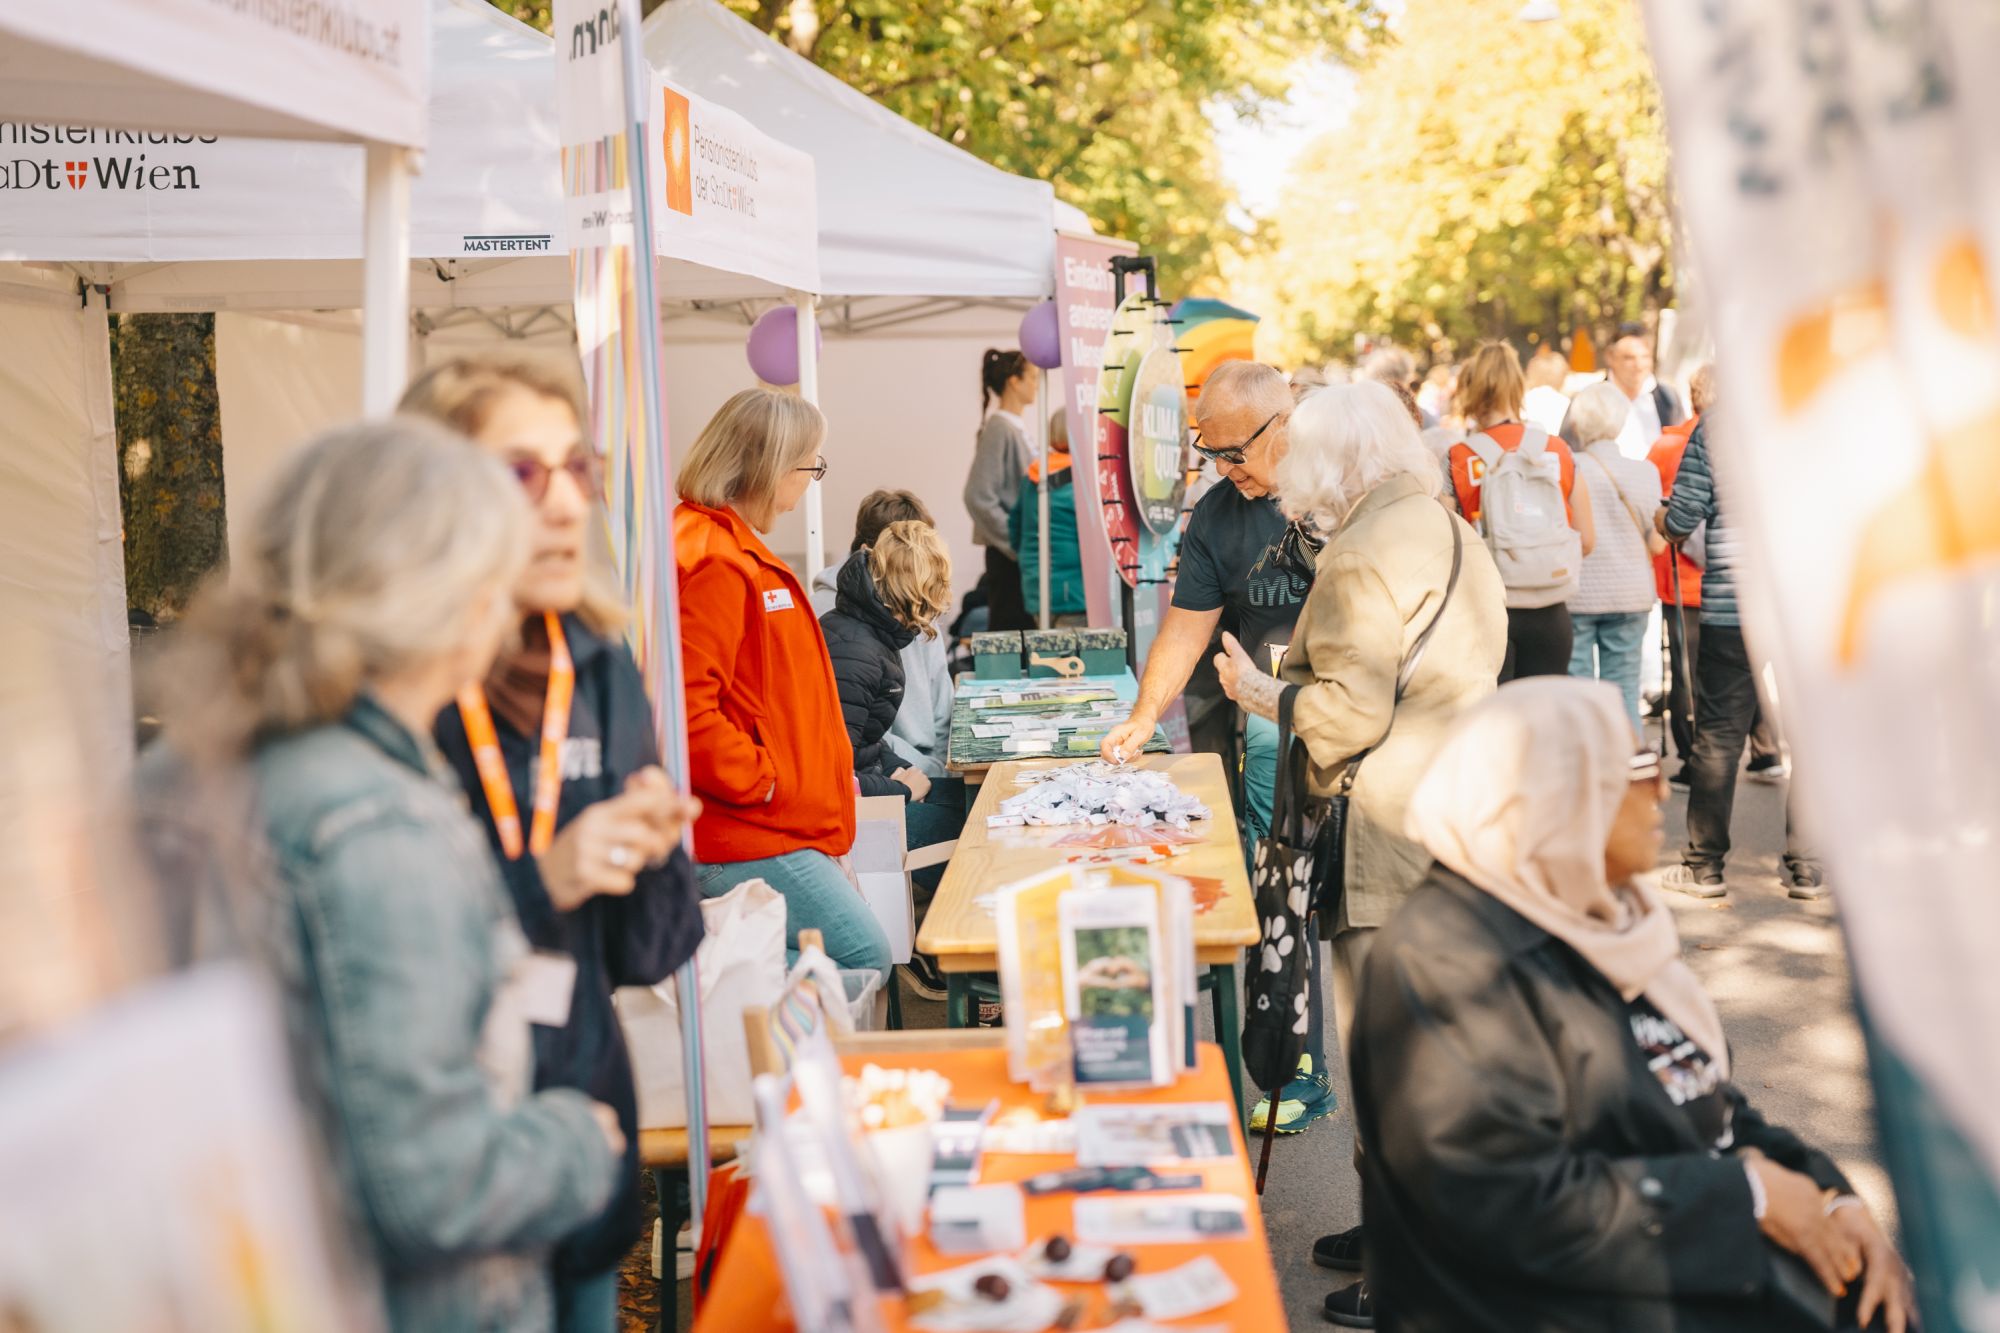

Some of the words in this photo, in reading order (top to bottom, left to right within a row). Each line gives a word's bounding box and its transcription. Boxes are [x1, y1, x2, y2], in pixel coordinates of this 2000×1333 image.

[93, 154, 200, 190] Wien
[463, 239, 551, 251] MASTERTENT
[1143, 403, 1180, 442] KLIMA
[1154, 444, 1182, 481] QUIZ
